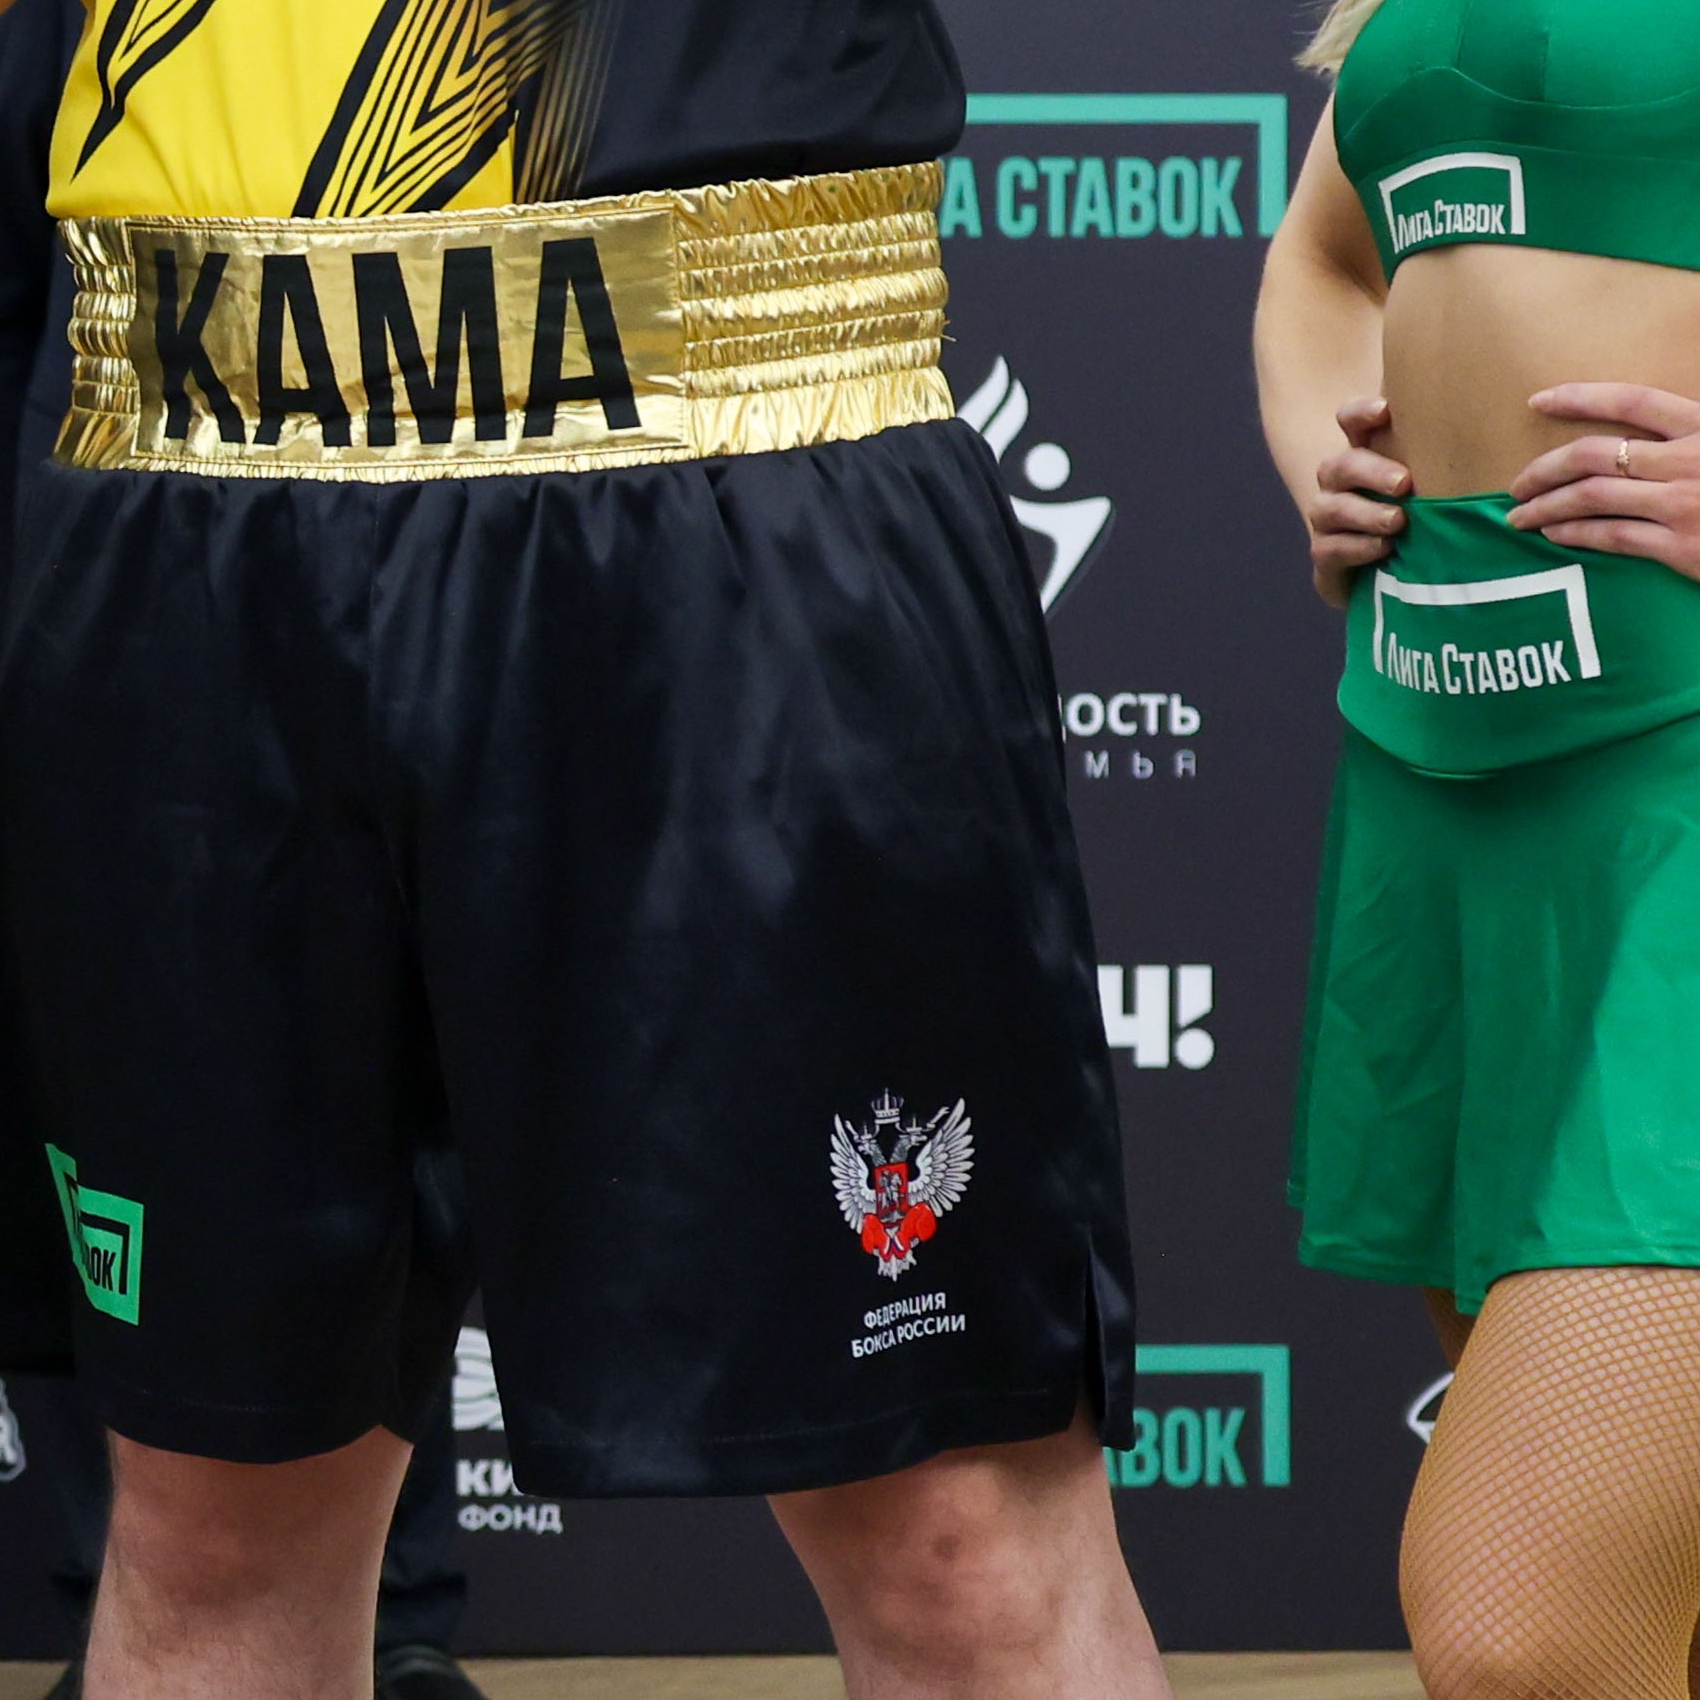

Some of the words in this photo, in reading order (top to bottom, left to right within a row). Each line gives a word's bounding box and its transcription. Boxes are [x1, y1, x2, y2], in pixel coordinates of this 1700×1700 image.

[996, 156, 1243, 239] СТАВОК
[155, 238, 643, 448] КАМА
[1058, 692, 1201, 743] ОСТЬ
[851, 1329, 898, 1358] БОКСА
[897, 1314, 966, 1344] РОССИИ
[863, 1292, 947, 1330] ФЕДЕРАЦИЯ
[1103, 1405, 1248, 1489] ВОК
[457, 1502, 564, 1535] ФОНД
